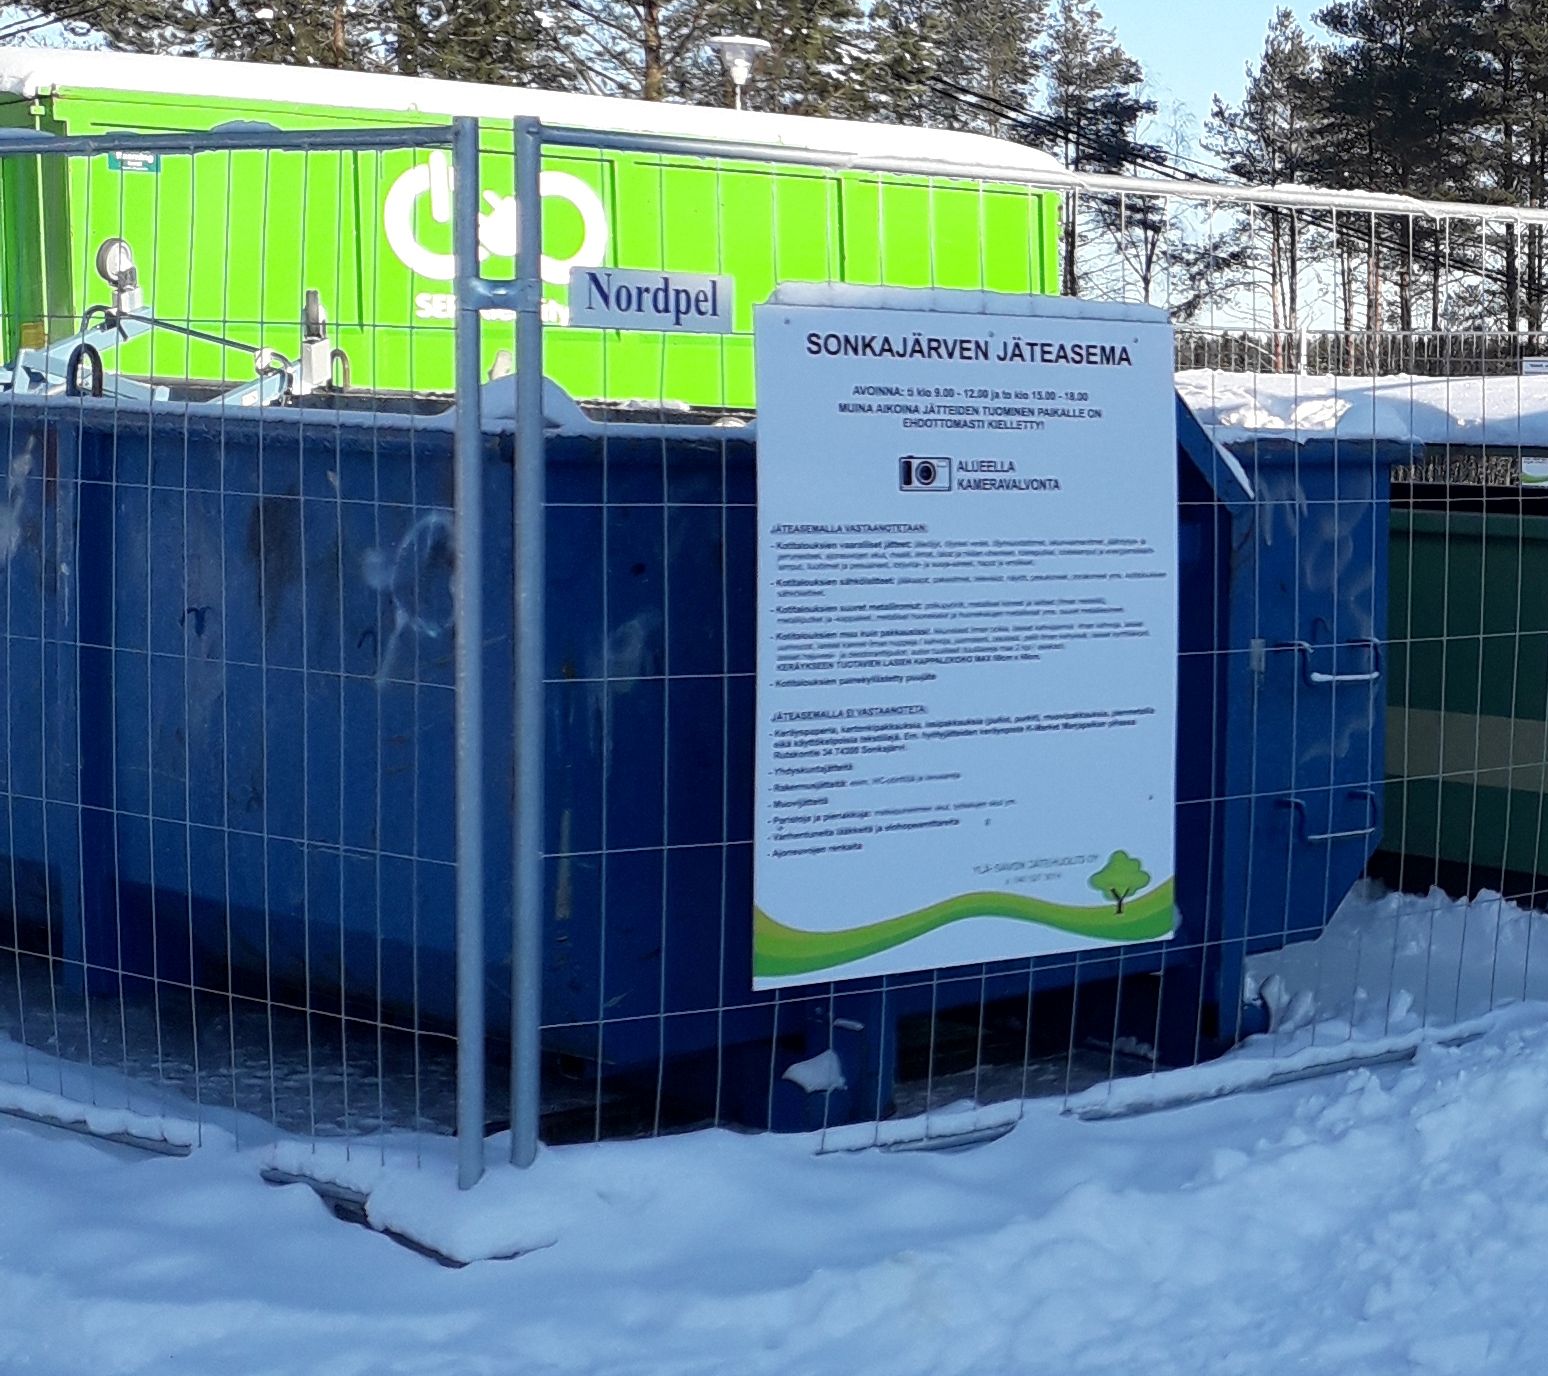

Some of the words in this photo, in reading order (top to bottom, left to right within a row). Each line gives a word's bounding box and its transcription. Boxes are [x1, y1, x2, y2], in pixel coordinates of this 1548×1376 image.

[584, 272, 719, 326] Nordpel
[806, 332, 991, 362] SONKAJÄRVEN
[996, 336, 1133, 367] JÄTEASEMA
[852, 386, 905, 398] AVOINNA:
[838, 403, 873, 414] MUINA
[875, 404, 920, 415] AIKOINA
[923, 403, 980, 416] JÄTTEIDEN
[982, 406, 1036, 417] TUOMINEN
[1037, 408, 1086, 419] PAIKALLE
[1088, 409, 1102, 419] ON
[903, 419, 985, 430] EHDOTTOMASTI
[957, 461, 1016, 473] ALUEELLA
[957, 479, 1060, 491] KAMERAVALVONTA
